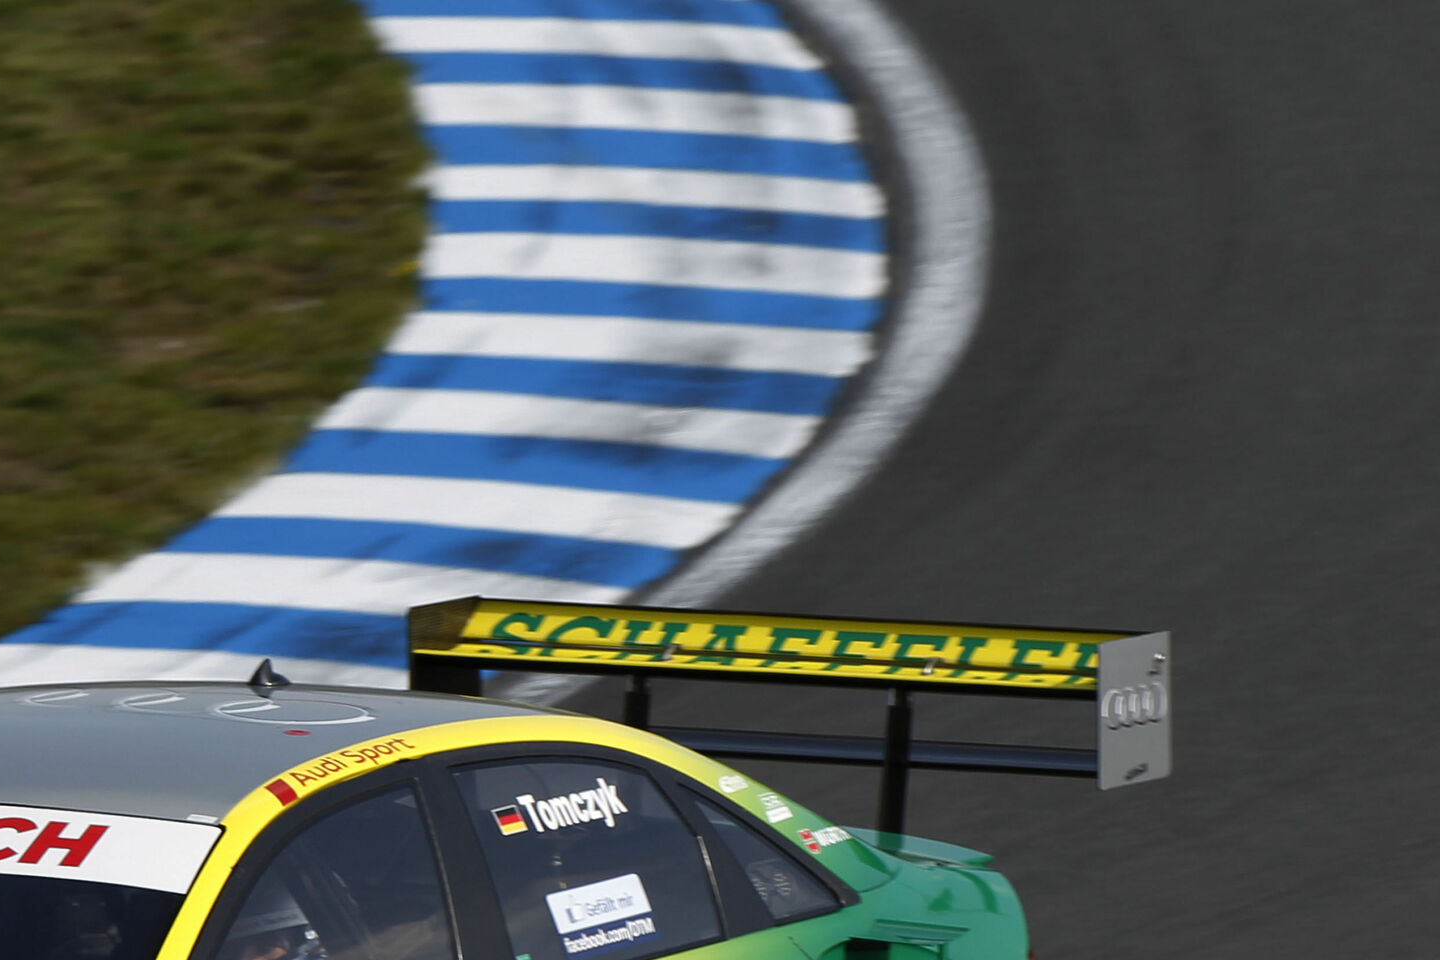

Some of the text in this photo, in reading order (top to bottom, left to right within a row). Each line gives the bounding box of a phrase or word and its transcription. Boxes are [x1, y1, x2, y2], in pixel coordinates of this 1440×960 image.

[289, 738, 416, 787] Audi Sport
[516, 777, 629, 833] Tomczyk
